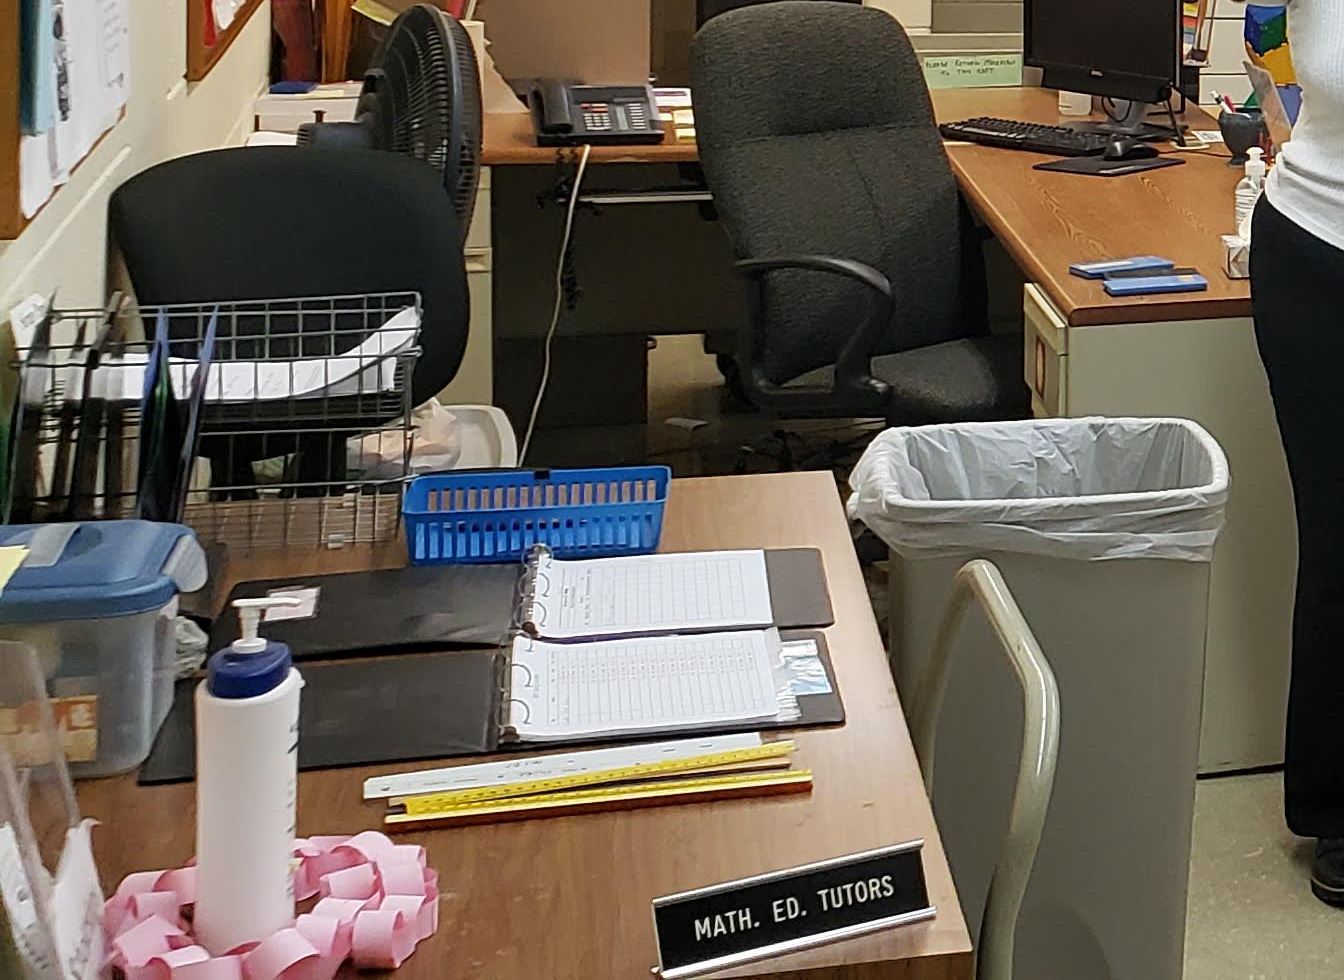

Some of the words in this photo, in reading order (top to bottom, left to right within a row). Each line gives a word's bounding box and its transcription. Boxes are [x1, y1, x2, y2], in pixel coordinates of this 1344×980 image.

[694, 908, 761, 941] MATH.
[772, 897, 807, 923] ED.
[817, 875, 895, 911] TUTORS
